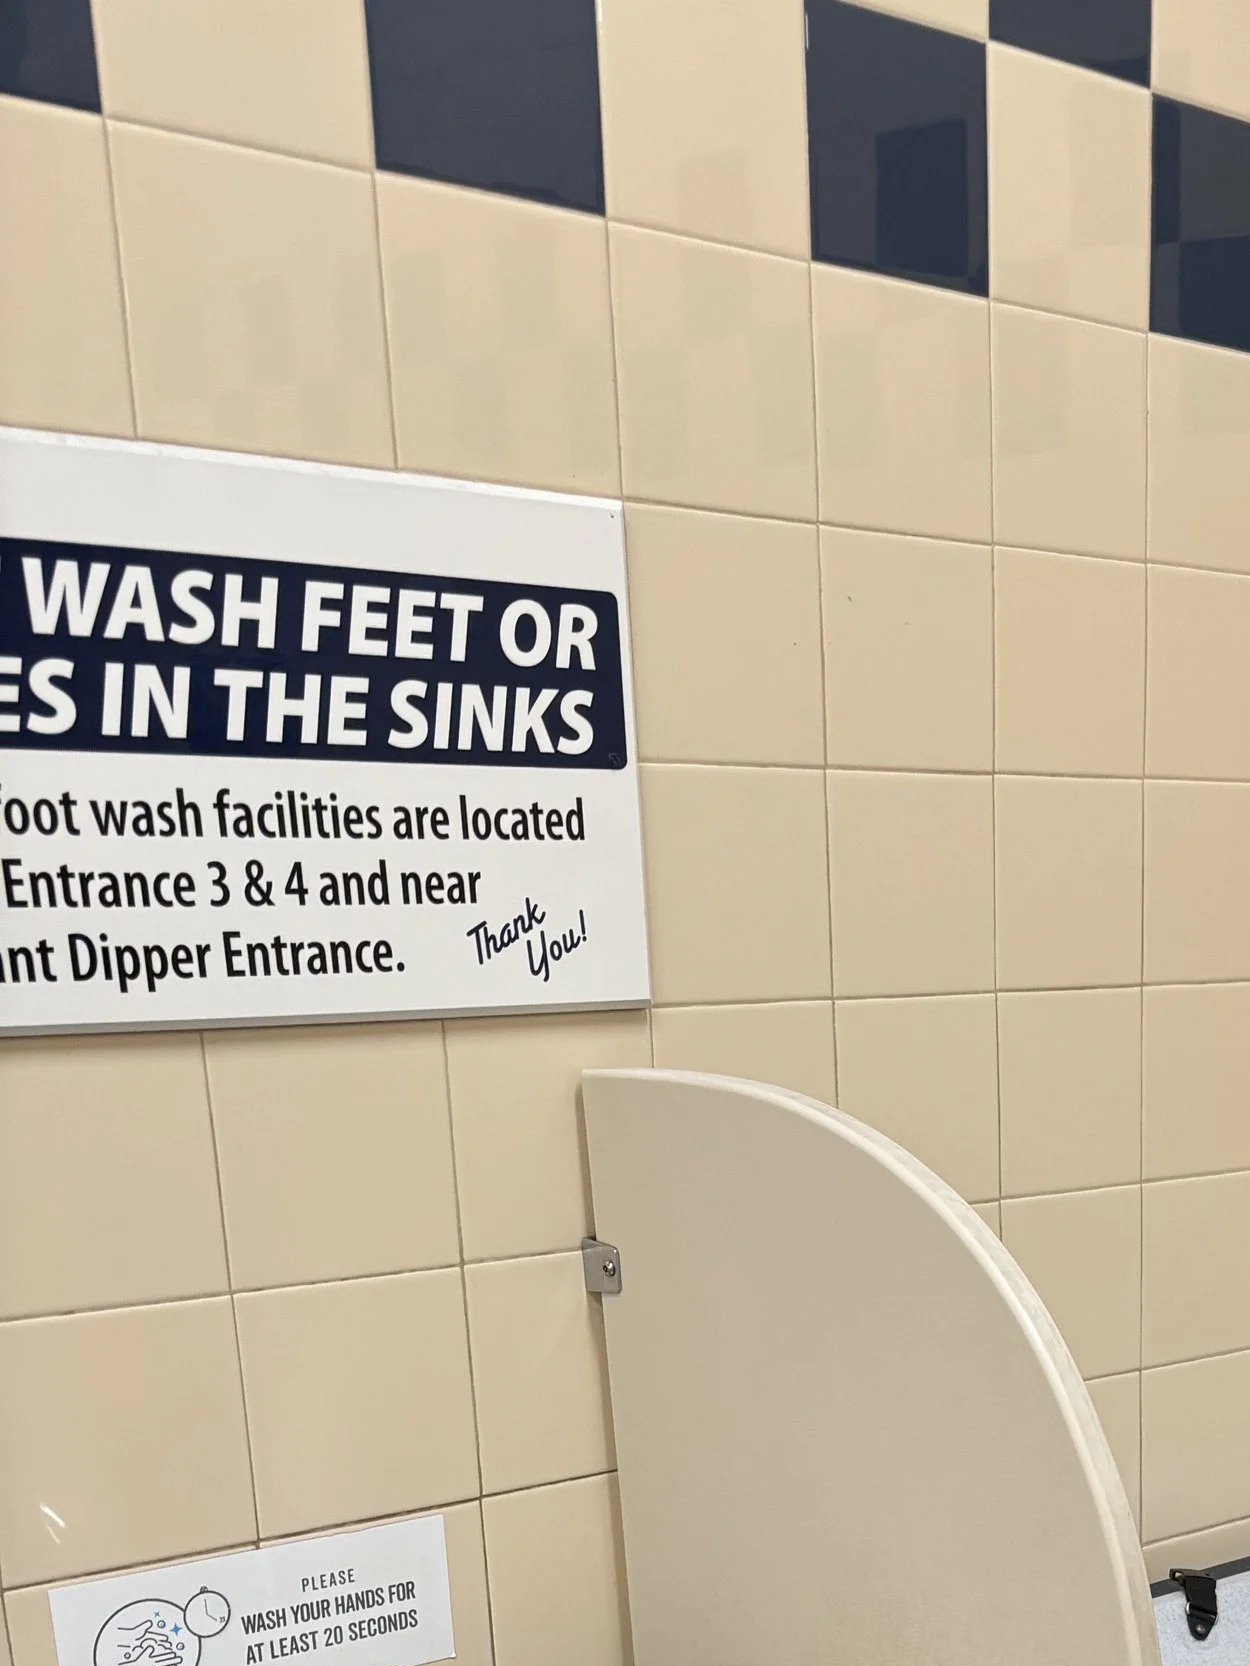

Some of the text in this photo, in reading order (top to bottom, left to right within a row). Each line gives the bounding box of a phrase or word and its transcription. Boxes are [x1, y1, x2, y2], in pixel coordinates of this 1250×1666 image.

[21, 556, 598, 670] WASH FEET OR
[101, 662, 191, 739] IN
[214, 668, 370, 746] THE
[387, 679, 594, 755] SINKS
[0, 784, 585, 841] oot wash facilities are located
[1, 858, 481, 908] Entrance 3 & 4 and near
[466, 897, 546, 965] Thank
[527, 909, 587, 982] You!
[0, 931, 405, 993] nt Dipper Entrance.
[241, 1580, 416, 1635] WASH YOUR HANDS FOR
[301, 1568, 355, 1593] PLEASE
[246, 1608, 419, 1665] AT LEAST 20 SECONDS
